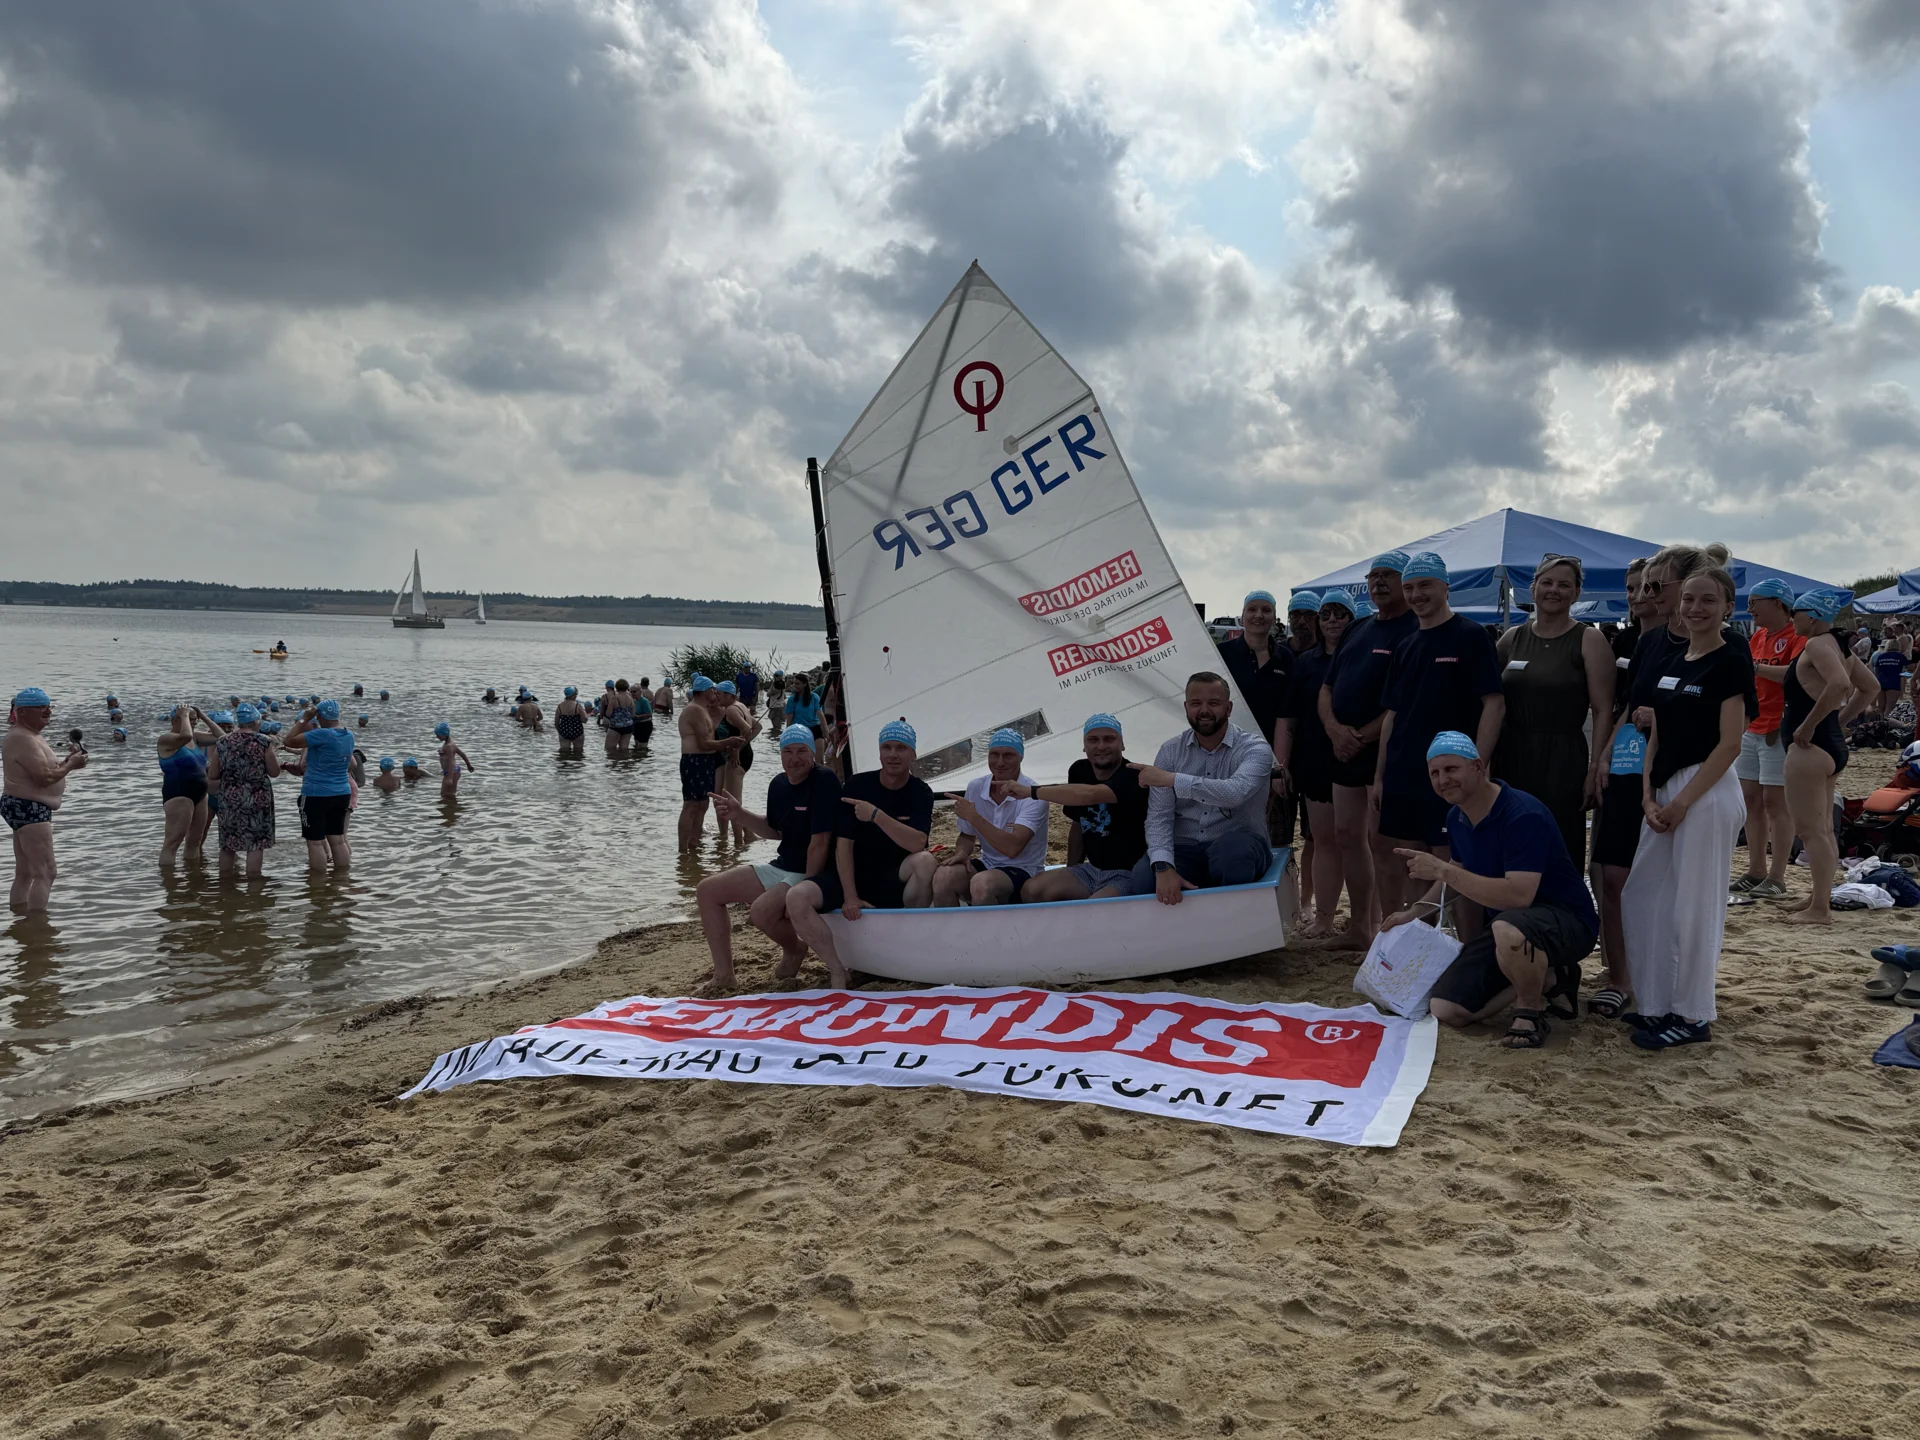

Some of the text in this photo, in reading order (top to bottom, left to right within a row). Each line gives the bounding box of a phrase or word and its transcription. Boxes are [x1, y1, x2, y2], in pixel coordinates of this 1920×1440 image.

[990, 415, 1107, 516] GER
[1052, 624, 1160, 673] REMONDIS
[1058, 679, 1072, 690] IM
[1075, 665, 1116, 685] AUFTRAG
[1137, 645, 1178, 670] ZUKUNFT
[423, 1038, 491, 1089] IM
